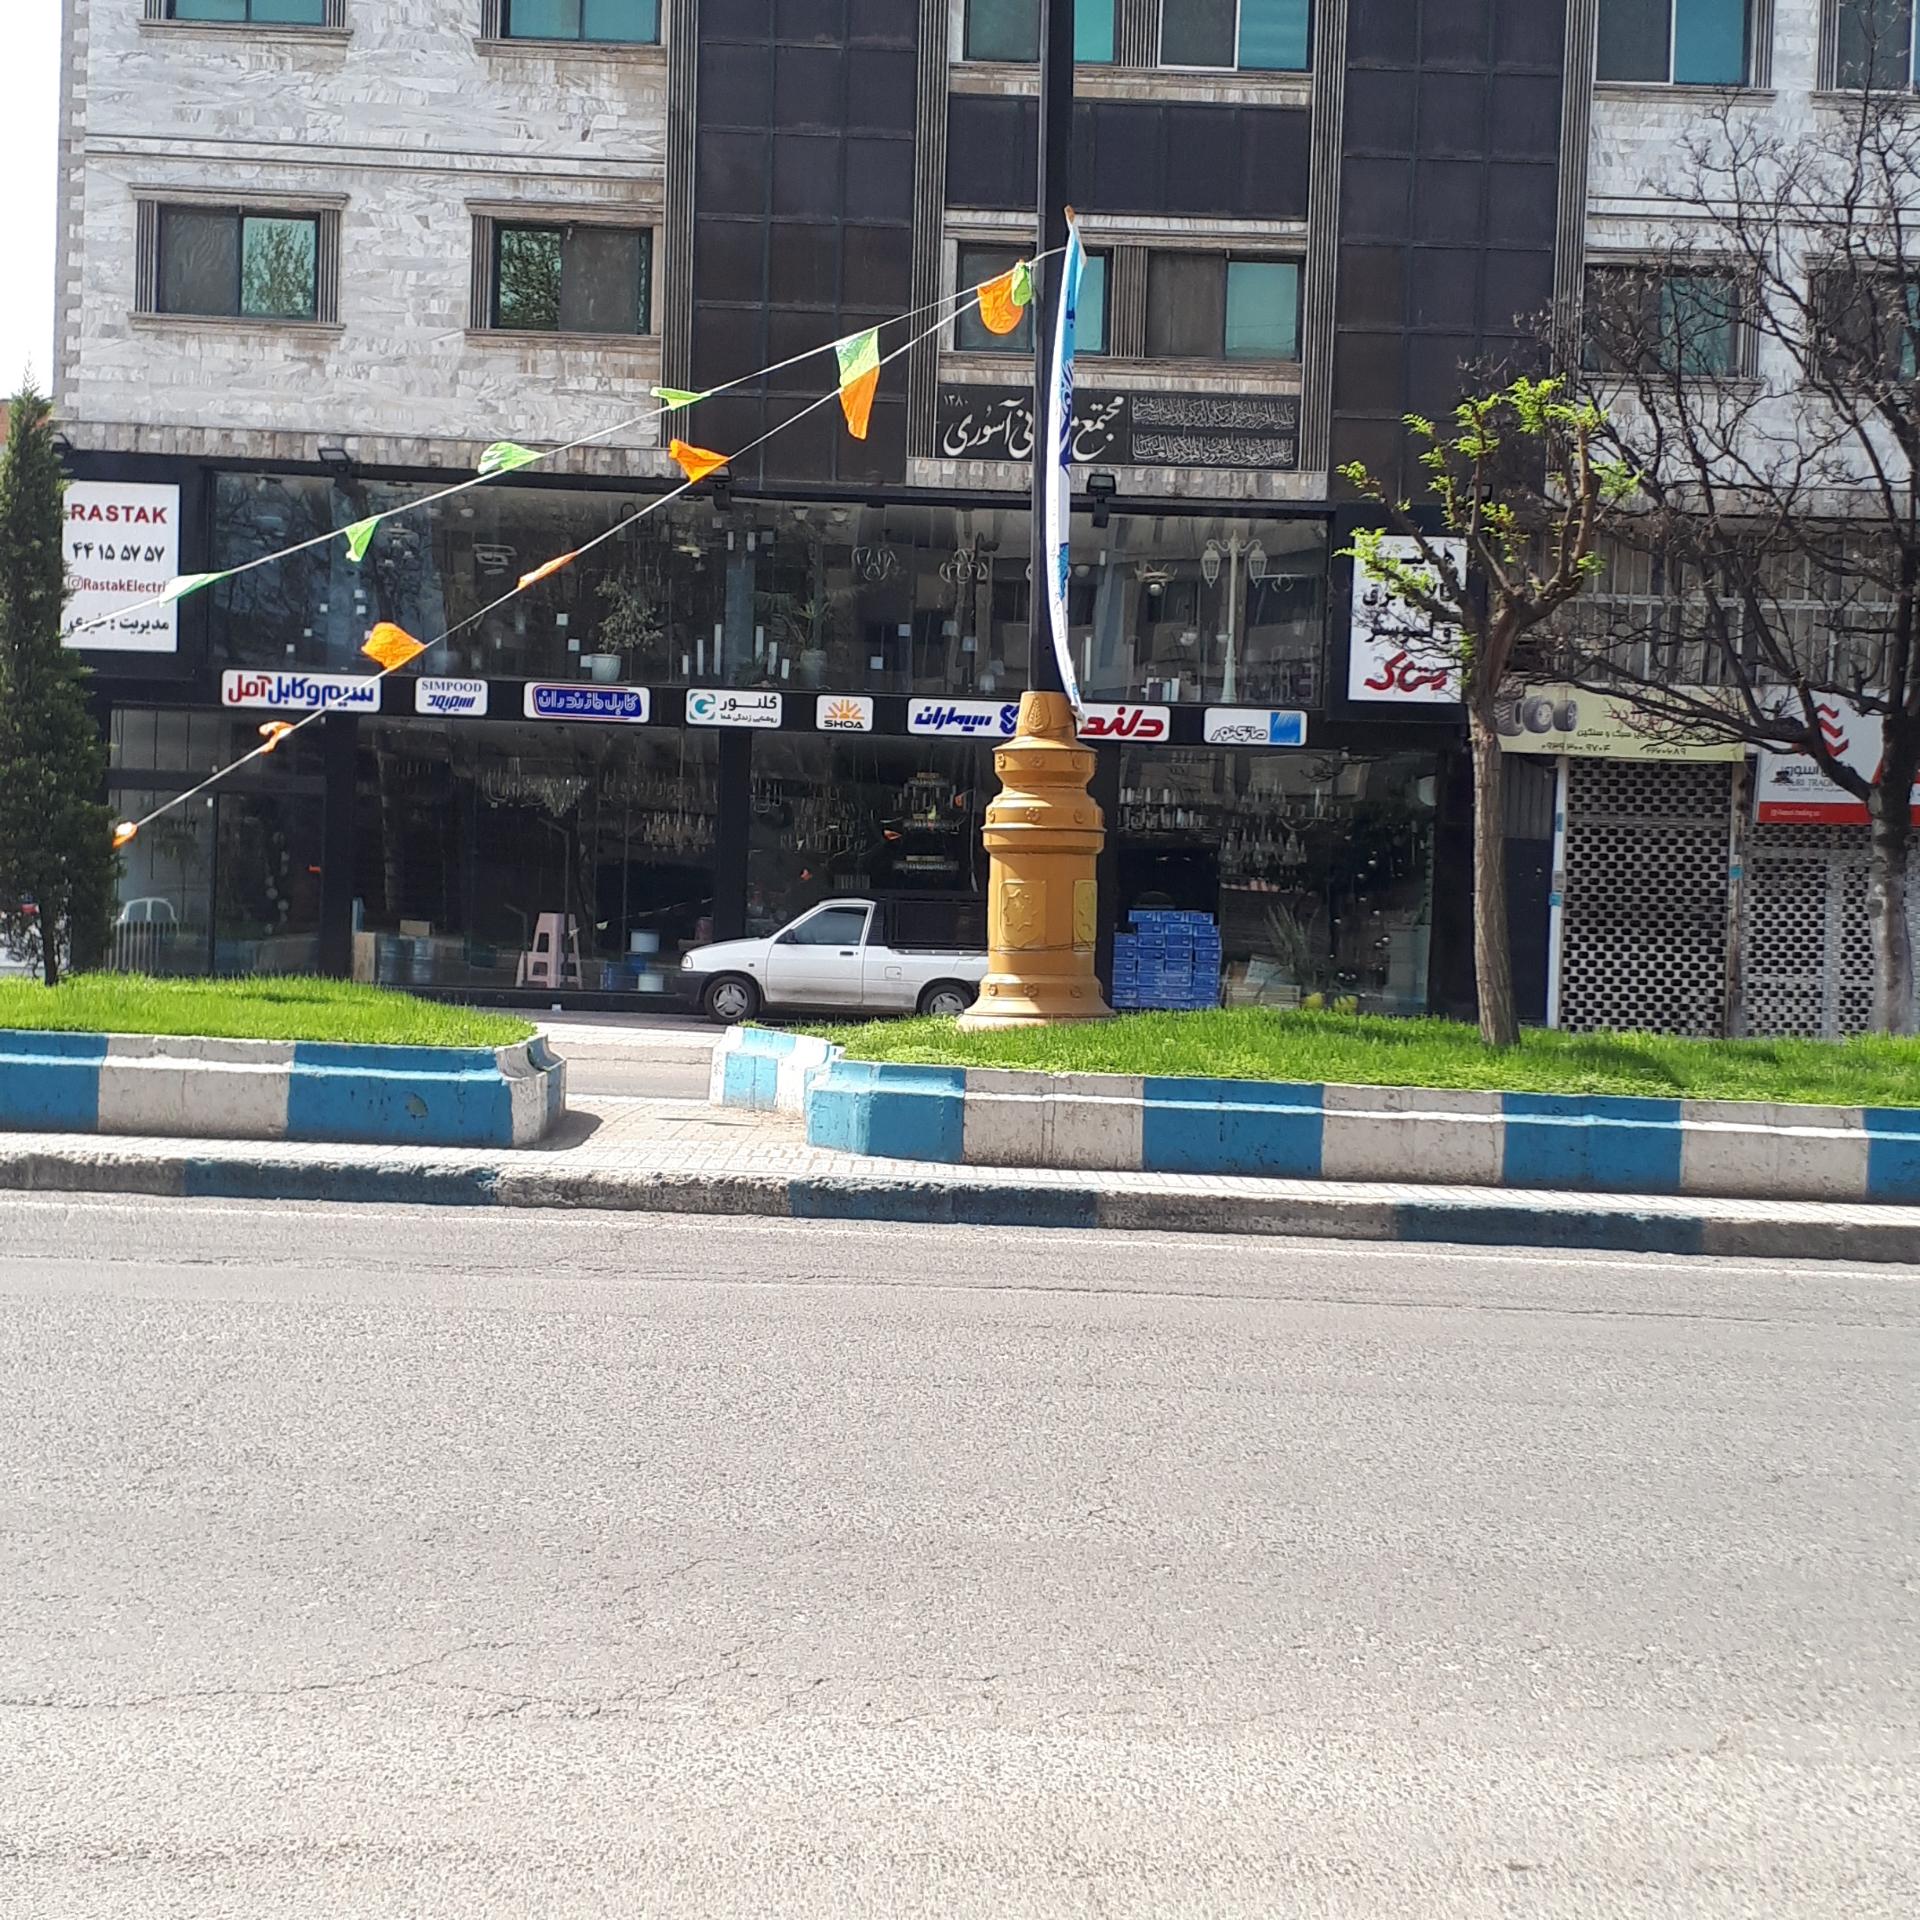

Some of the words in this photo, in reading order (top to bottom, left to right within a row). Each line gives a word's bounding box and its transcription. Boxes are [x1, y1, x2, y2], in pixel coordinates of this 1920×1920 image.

[1072, 396, 1125, 461] مجتمع
[70, 503, 168, 524] RASTAK
[72, 542, 94, 559] ۴۴
[99, 544, 115, 560] ۱۵
[121, 544, 141, 561] ۵۷
[144, 545, 165, 562] ۵۷
[83, 578, 166, 593] RastakElectri
[119, 618, 169, 634] مدیریت
[228, 674, 272, 703] آمل
[421, 681, 482, 693] SIMPOOD
[824, 720, 864, 729] SHOA
[914, 705, 992, 732] سیماران
